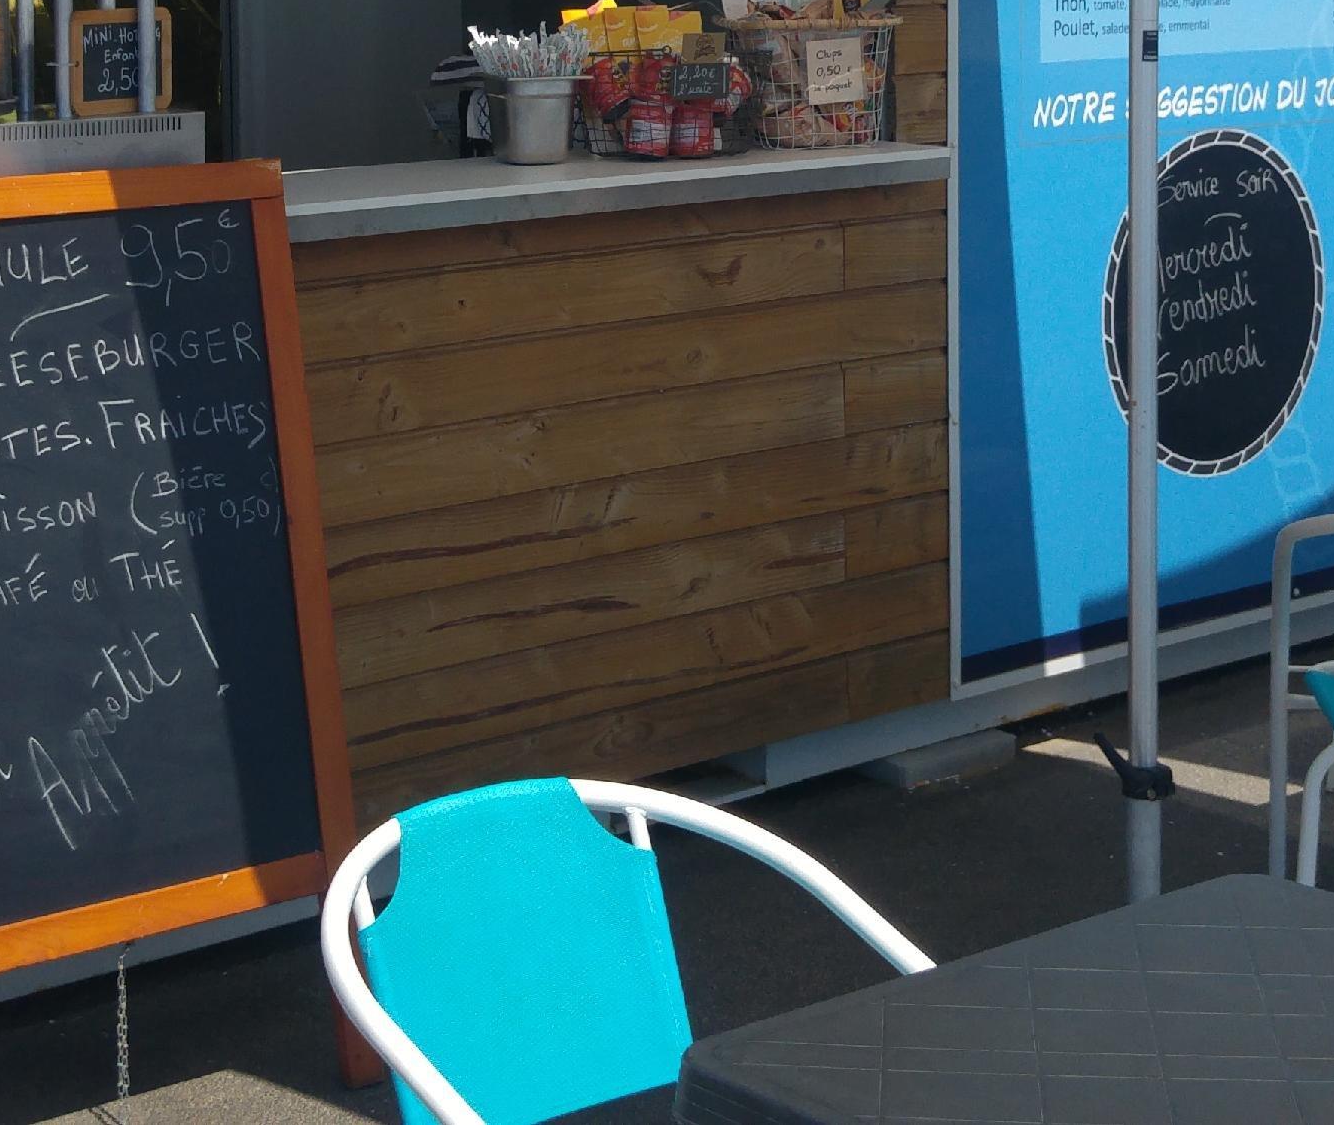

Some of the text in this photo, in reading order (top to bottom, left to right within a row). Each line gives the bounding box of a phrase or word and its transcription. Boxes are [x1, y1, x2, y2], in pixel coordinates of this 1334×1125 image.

[1053, 19, 1099, 38] Poulet,
[1034, 91, 1116, 127] NOTRE
[1276, 76, 1307, 109] DU
[109, 539, 183, 592] THÉ
